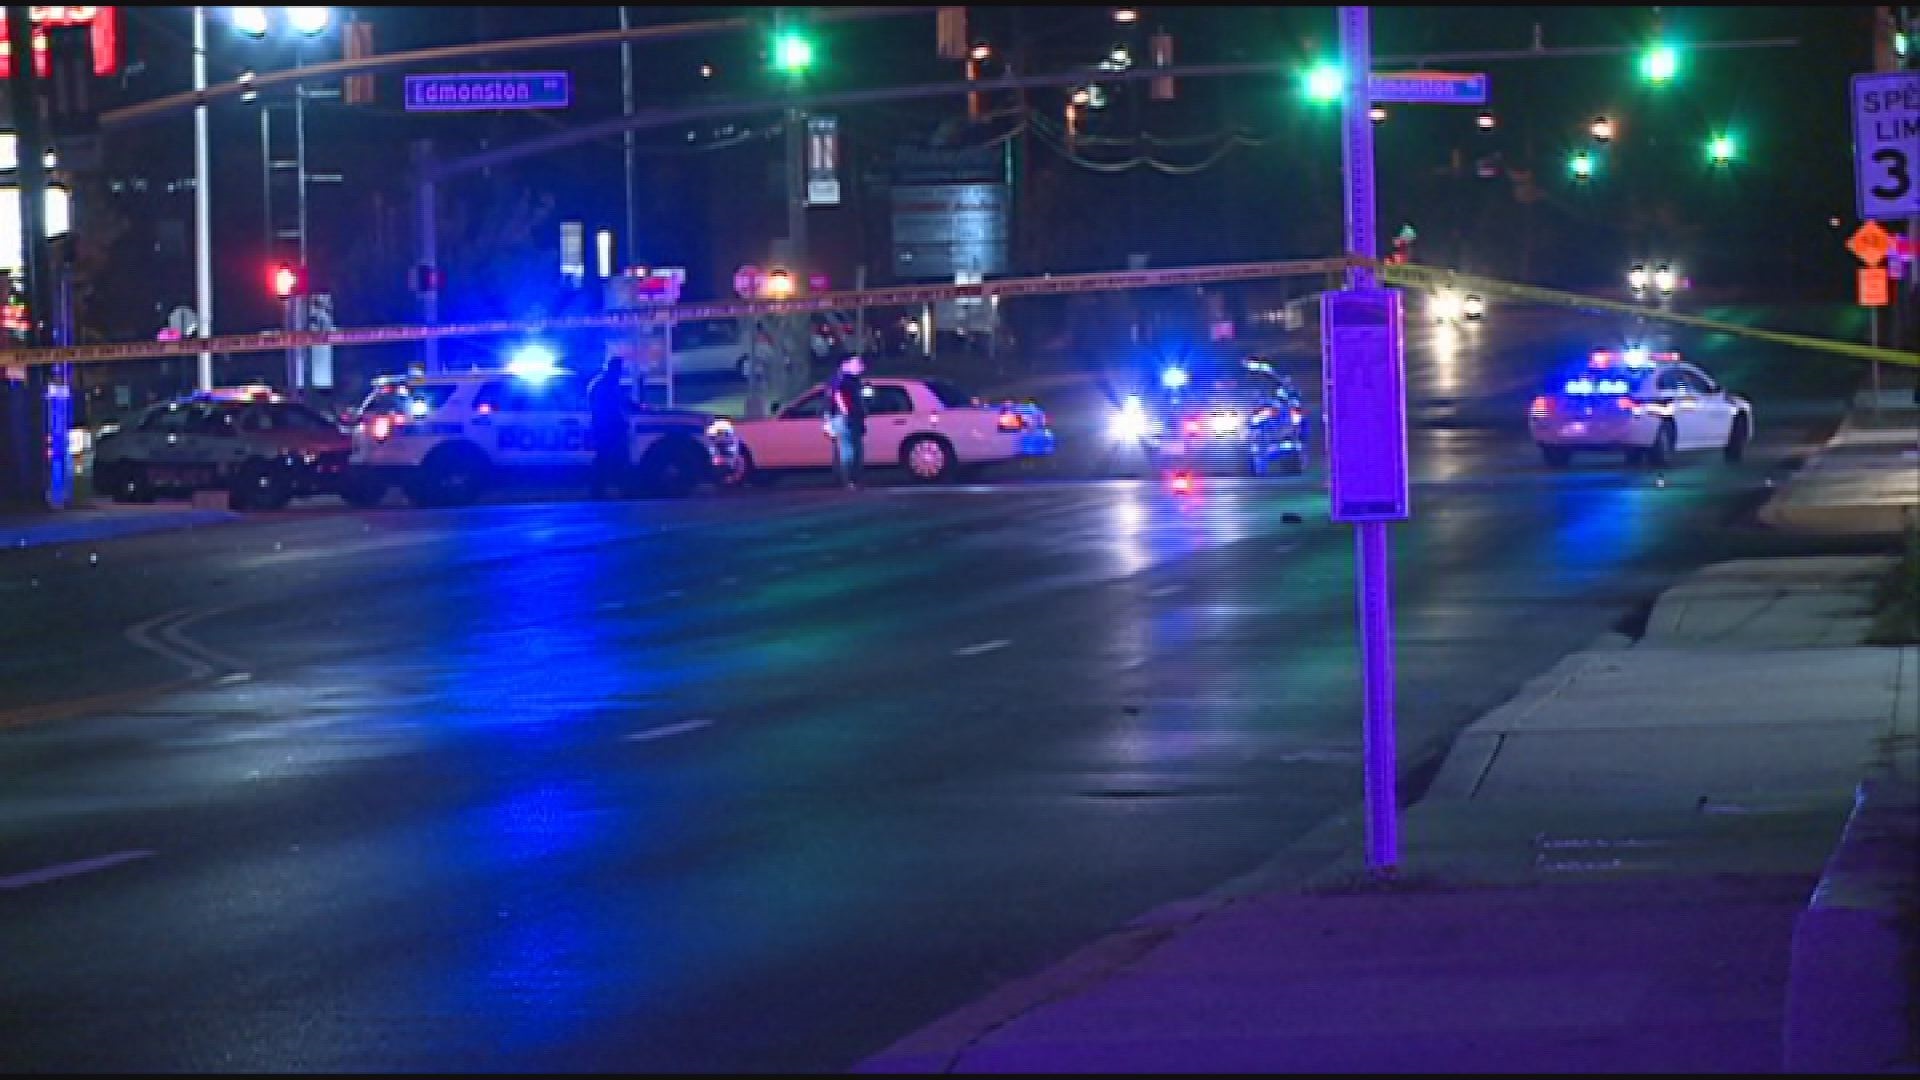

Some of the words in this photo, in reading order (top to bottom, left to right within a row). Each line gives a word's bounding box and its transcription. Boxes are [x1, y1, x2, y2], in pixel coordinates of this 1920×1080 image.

[415, 81, 529, 103] Edmonston
[1872, 149, 1911, 198] 3
[498, 425, 592, 451] POLIC
